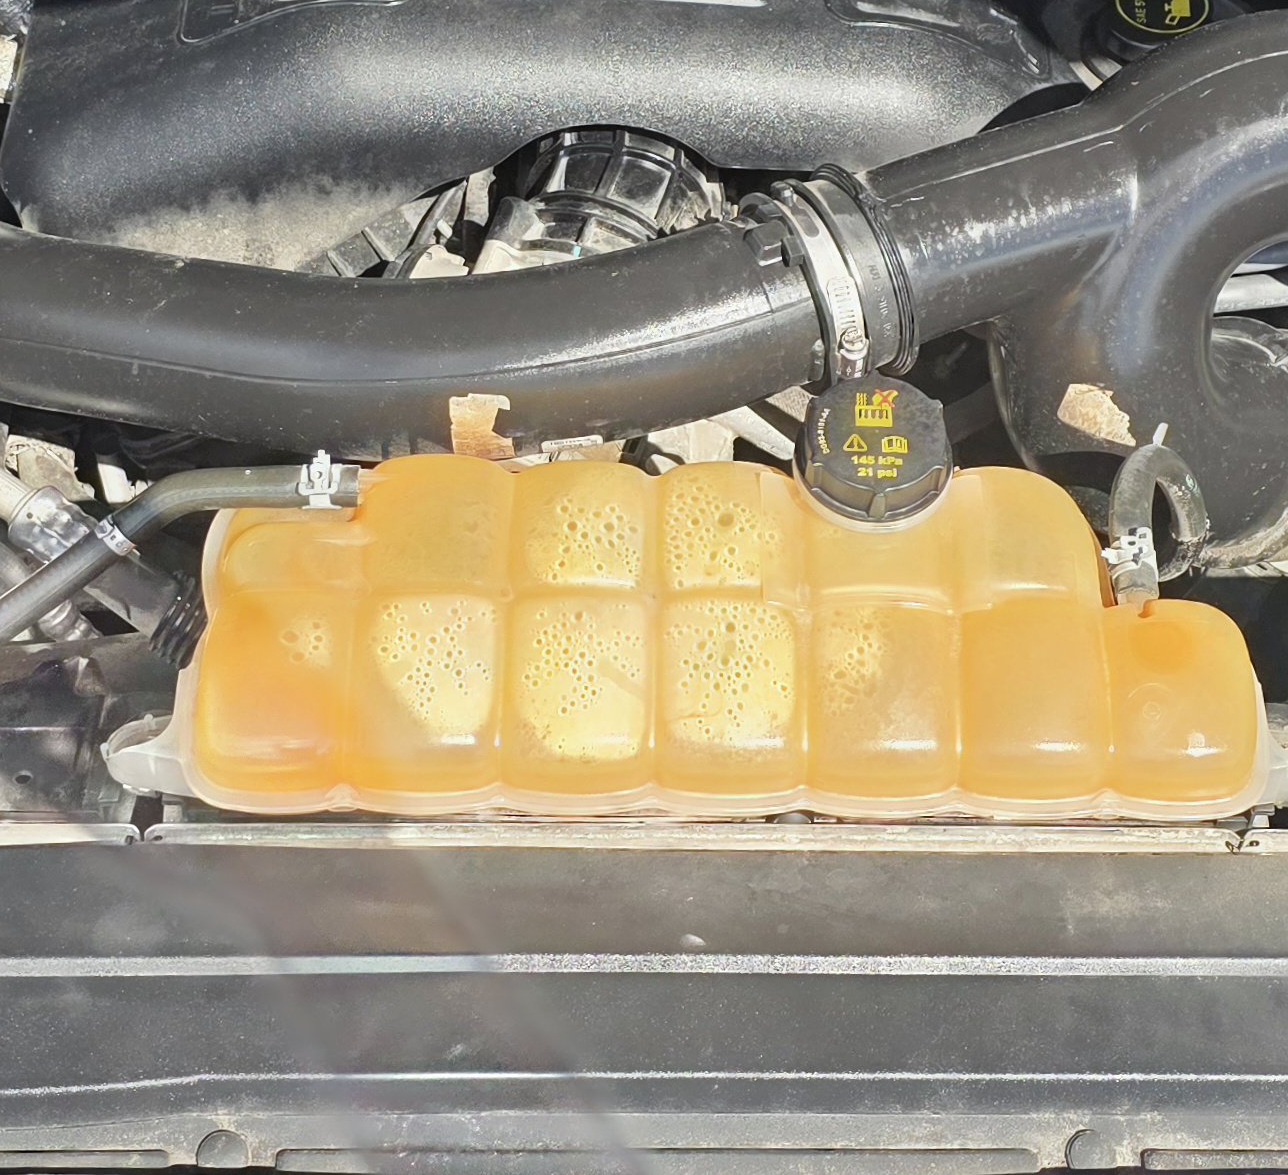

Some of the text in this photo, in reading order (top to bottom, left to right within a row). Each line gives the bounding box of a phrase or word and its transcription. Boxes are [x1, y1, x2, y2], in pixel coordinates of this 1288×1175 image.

[1135, 8, 1147, 24] SAE
[850, 455, 903, 466] 145 kPa
[856, 467, 899, 479] 21 psi
